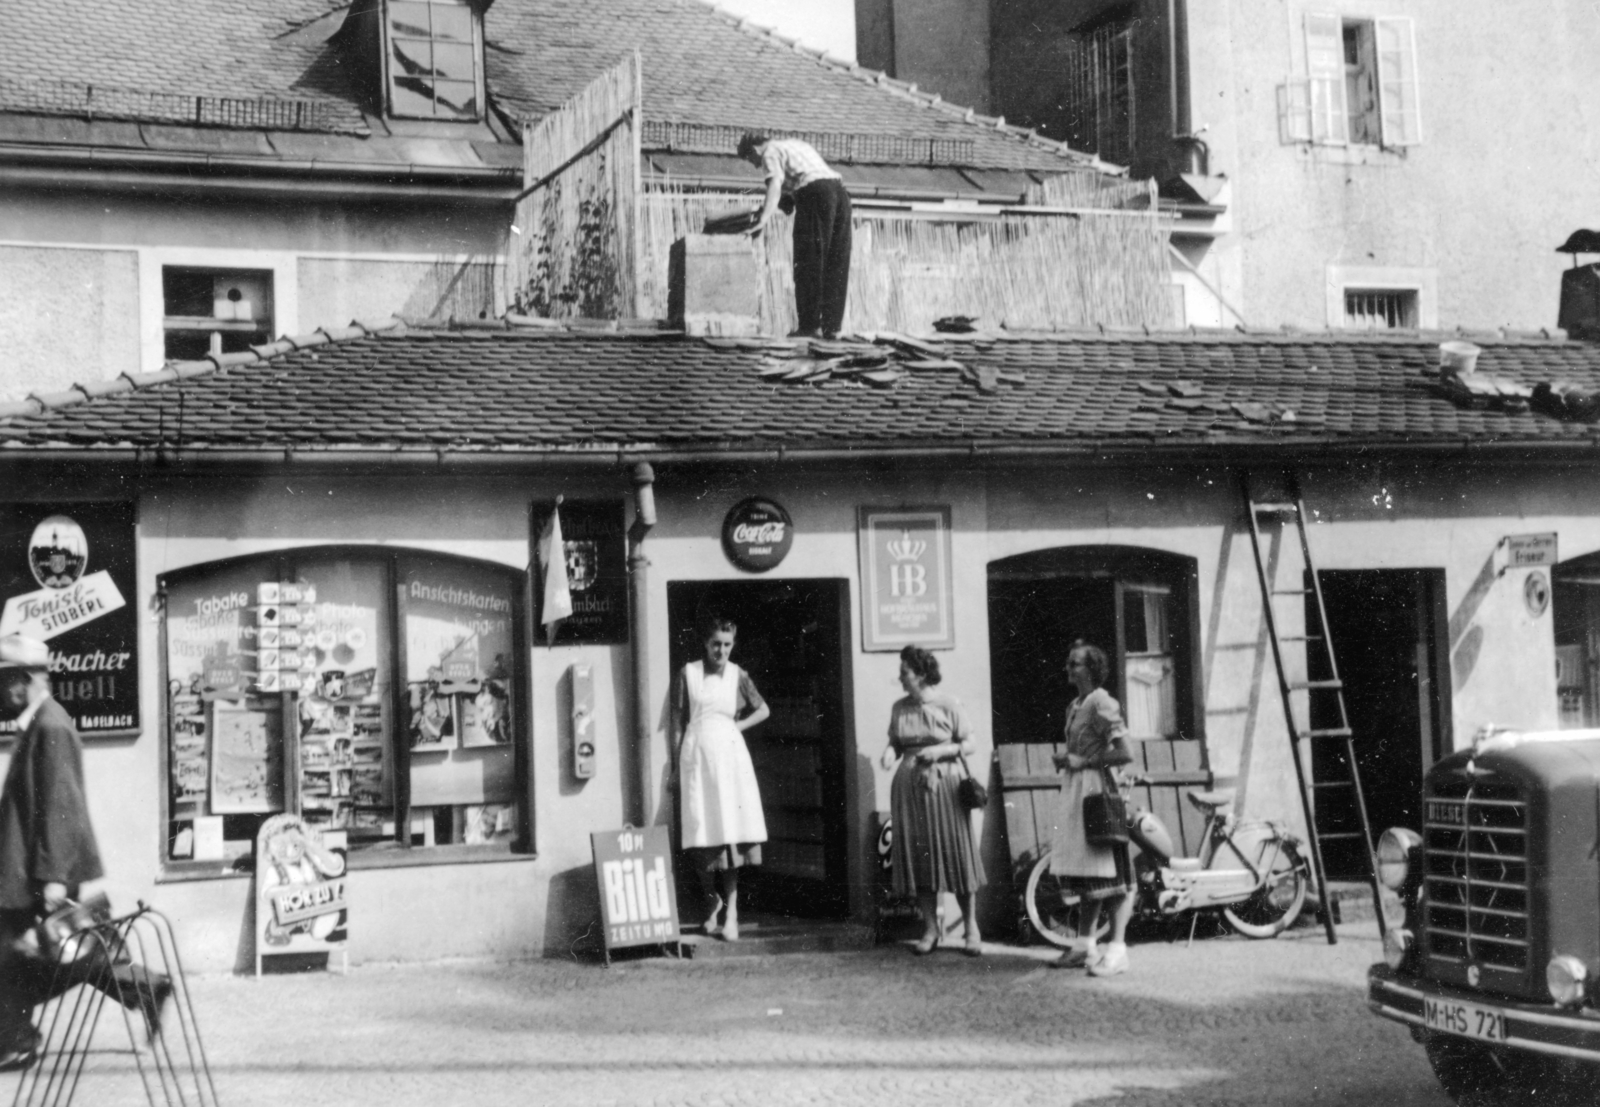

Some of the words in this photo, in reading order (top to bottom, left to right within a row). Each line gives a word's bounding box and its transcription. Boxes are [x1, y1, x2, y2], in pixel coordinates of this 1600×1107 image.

[890, 564, 927, 596] HB
[194, 590, 248, 617] Tabake
[410, 580, 509, 612] Ansichtskarten
[52, 675, 115, 701] uell
[602, 856, 671, 925] Bild
[610, 921, 673, 942] ZEITUNG
